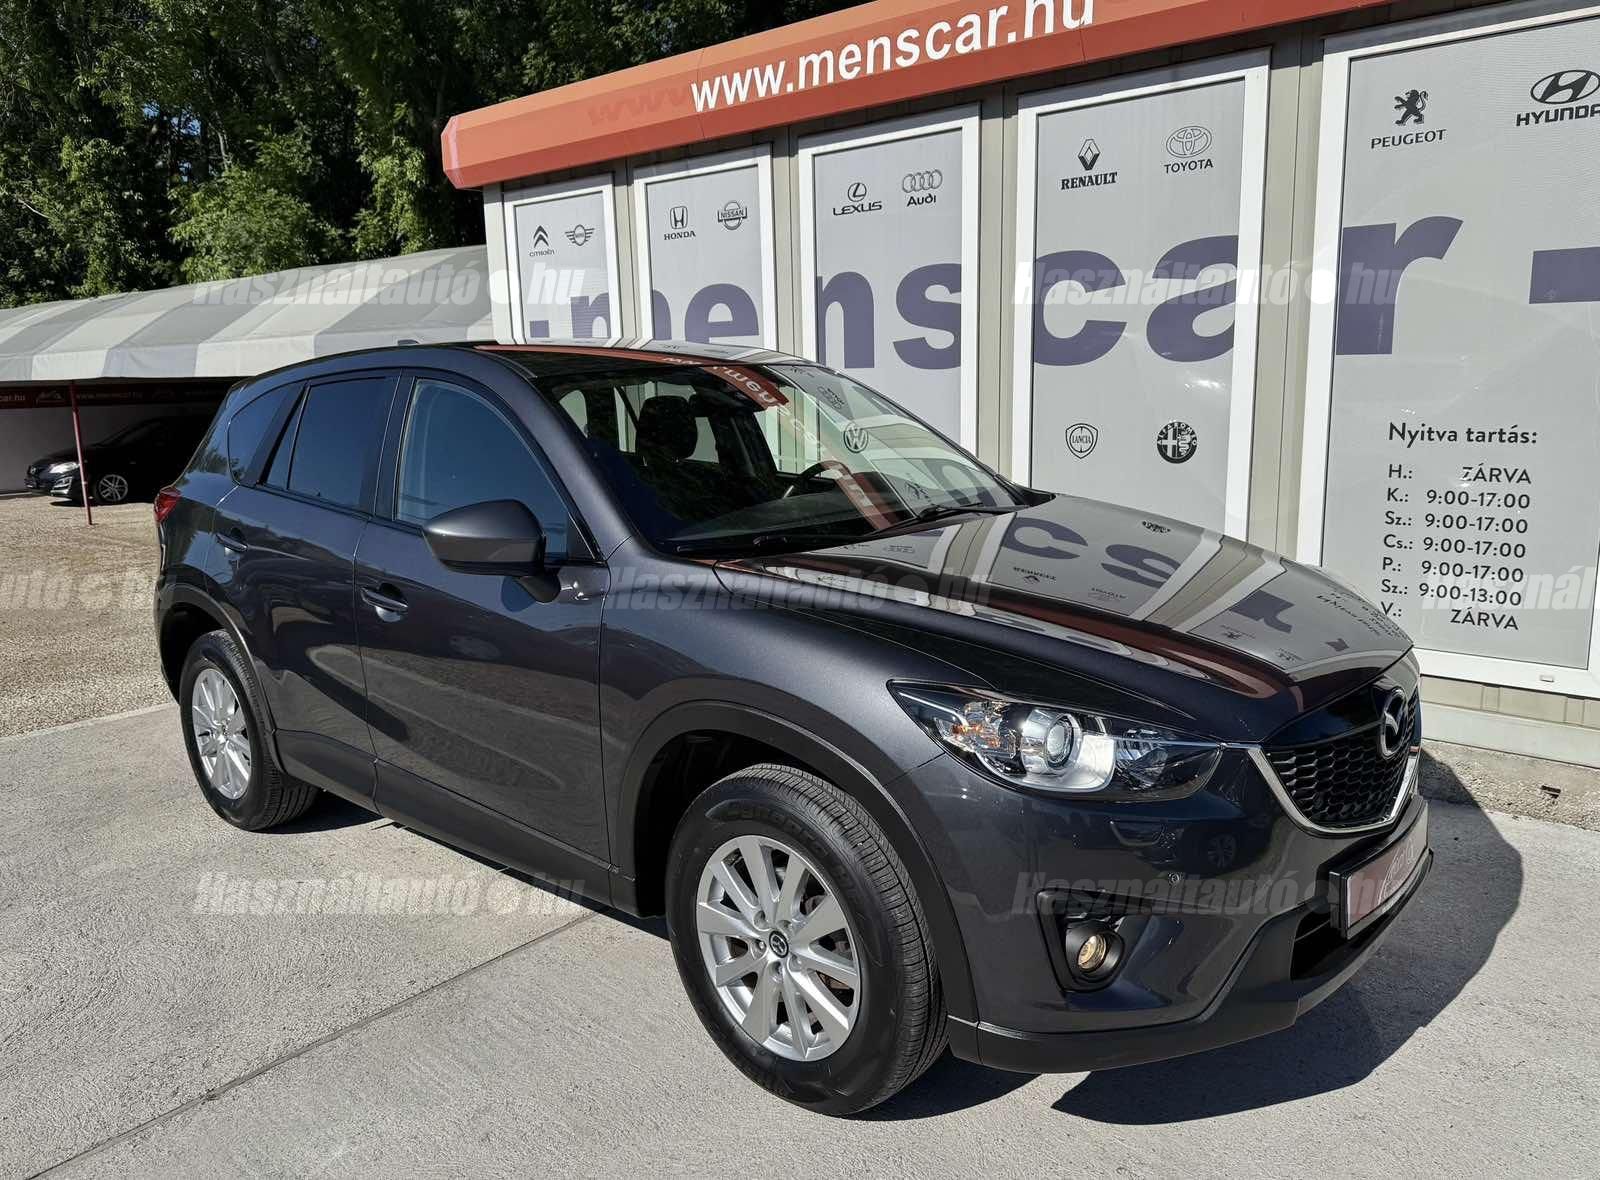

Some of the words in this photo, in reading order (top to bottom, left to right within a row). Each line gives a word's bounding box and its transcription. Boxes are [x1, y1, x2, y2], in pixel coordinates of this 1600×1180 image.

[691, 0, 1094, 112] www.menscar.hu
[1371, 129, 1446, 149] PEUGEOT
[1164, 158, 1214, 174] TOYOTA
[1061, 172, 1118, 190] RENAULT
[832, 200, 882, 216] LEXUS
[906, 193, 937, 207] Audi
[719, 208, 745, 219] NISSAN
[664, 231, 696, 241] HONDA
[1388, 422, 1458, 448] Nyitva
[1466, 425, 1538, 444] tartás:
[1388, 464, 1413, 480] H.:
[1462, 463, 1532, 485] ZÁRVA
[1387, 488, 1409, 503] K.:
[1426, 489, 1531, 509] 9:00-17:00
[1384, 511, 1412, 526] Sz.:
[1424, 513, 1528, 534] 9:00-17:00
[1383, 534, 1413, 550] Cs.:
[1423, 537, 1526, 558] 9:00-17:00
[1382, 557, 1402, 572] P.:
[1421, 560, 1524, 583] 9:00-17:00
[1381, 579, 1408, 595] Sz.:
[1419, 582, 1522, 606] 9:00-13:00
[1380, 602, 1402, 617] V.:
[1450, 607, 1519, 630] ZÁRVA
